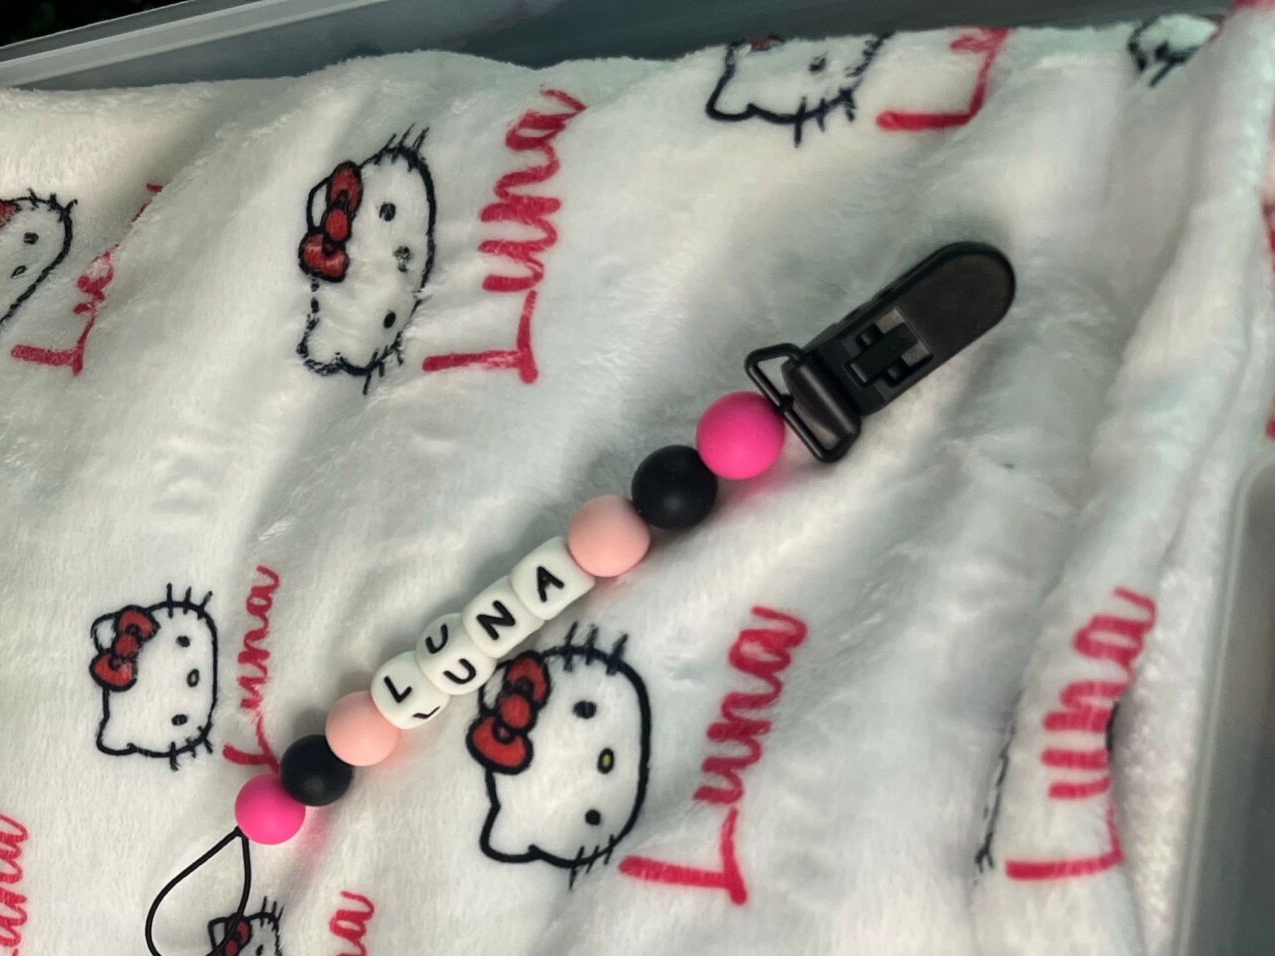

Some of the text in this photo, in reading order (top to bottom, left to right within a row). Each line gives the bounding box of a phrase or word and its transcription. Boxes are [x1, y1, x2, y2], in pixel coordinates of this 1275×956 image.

[423, 84, 589, 385] Luna
[222, 565, 281, 776] Luna
[384, 565, 566, 703] LUNA
[619, 605, 809, 906] Luna
